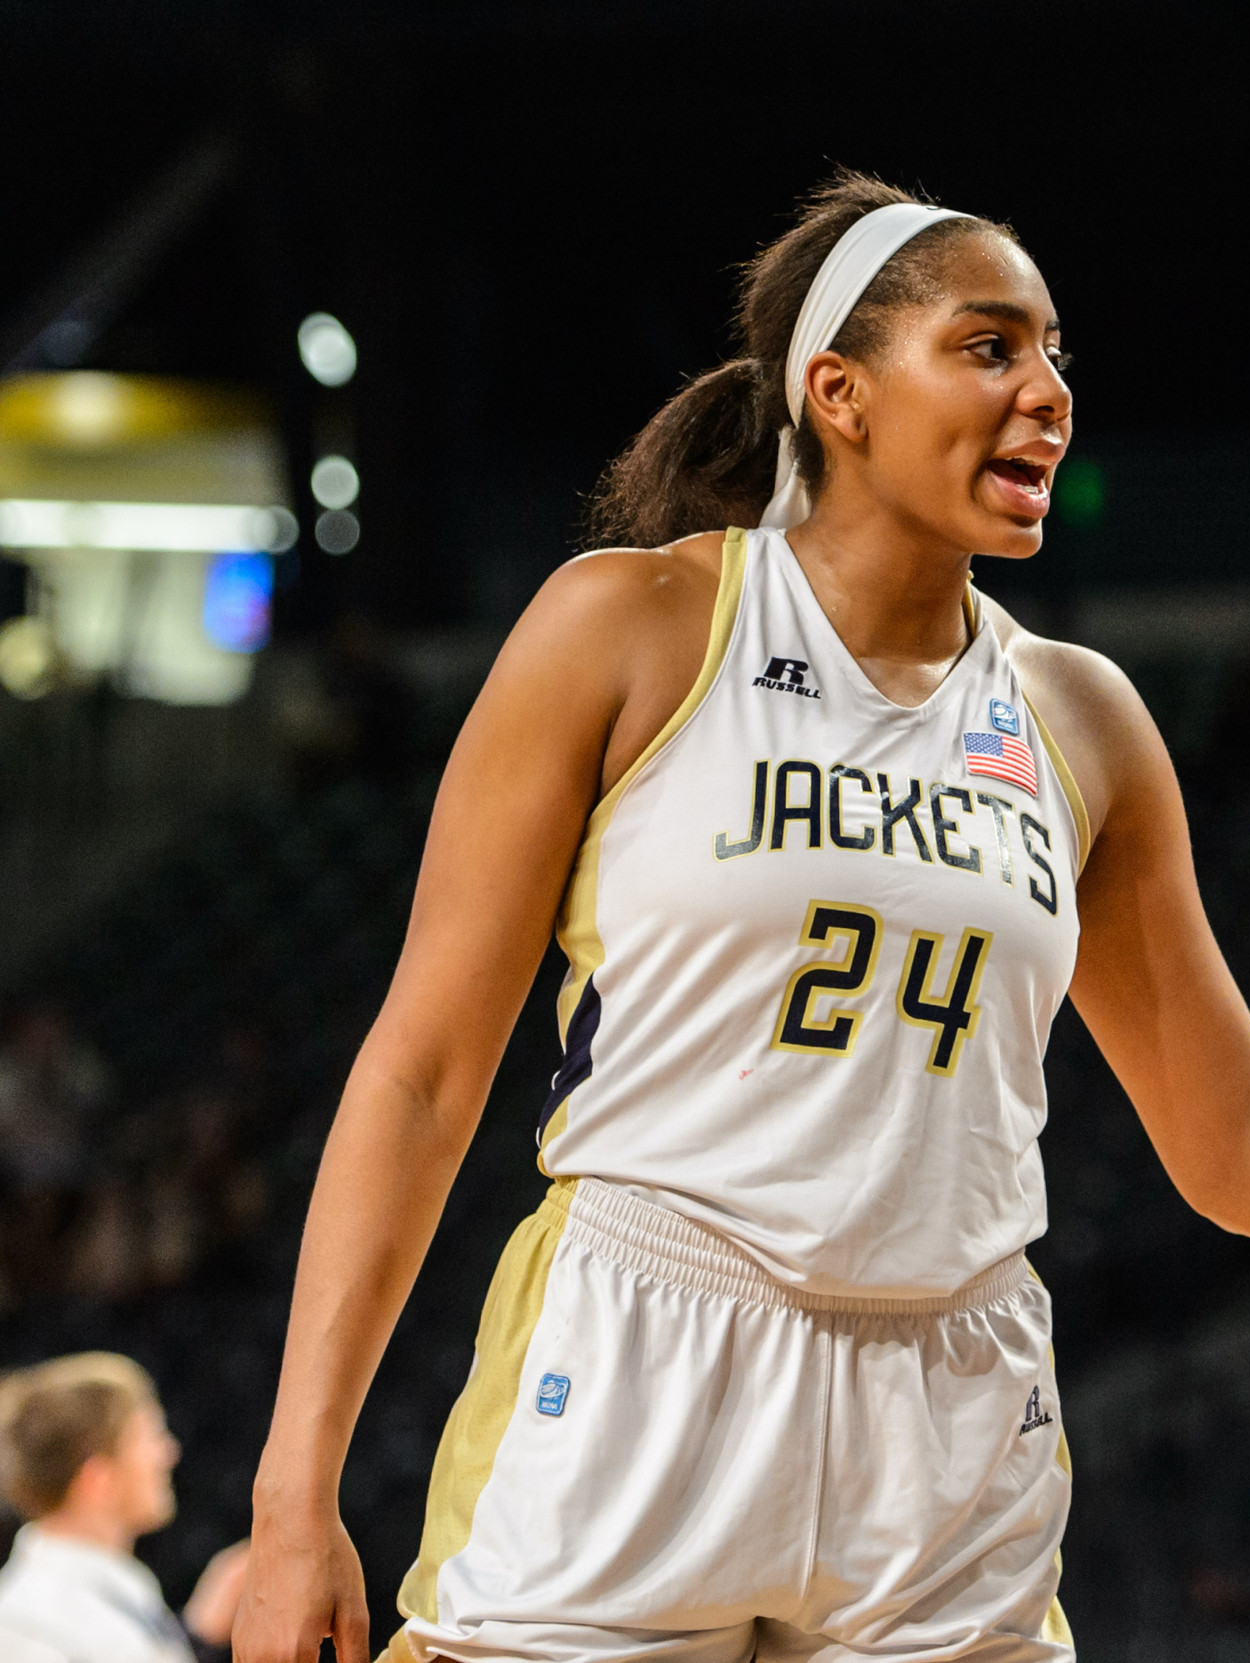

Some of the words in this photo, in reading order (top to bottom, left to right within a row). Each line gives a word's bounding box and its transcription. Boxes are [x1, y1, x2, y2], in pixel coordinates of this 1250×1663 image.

[752, 676, 822, 699] RUSSELL
[713, 759, 1058, 916] JACKETS
[770, 899, 994, 1078] 24
